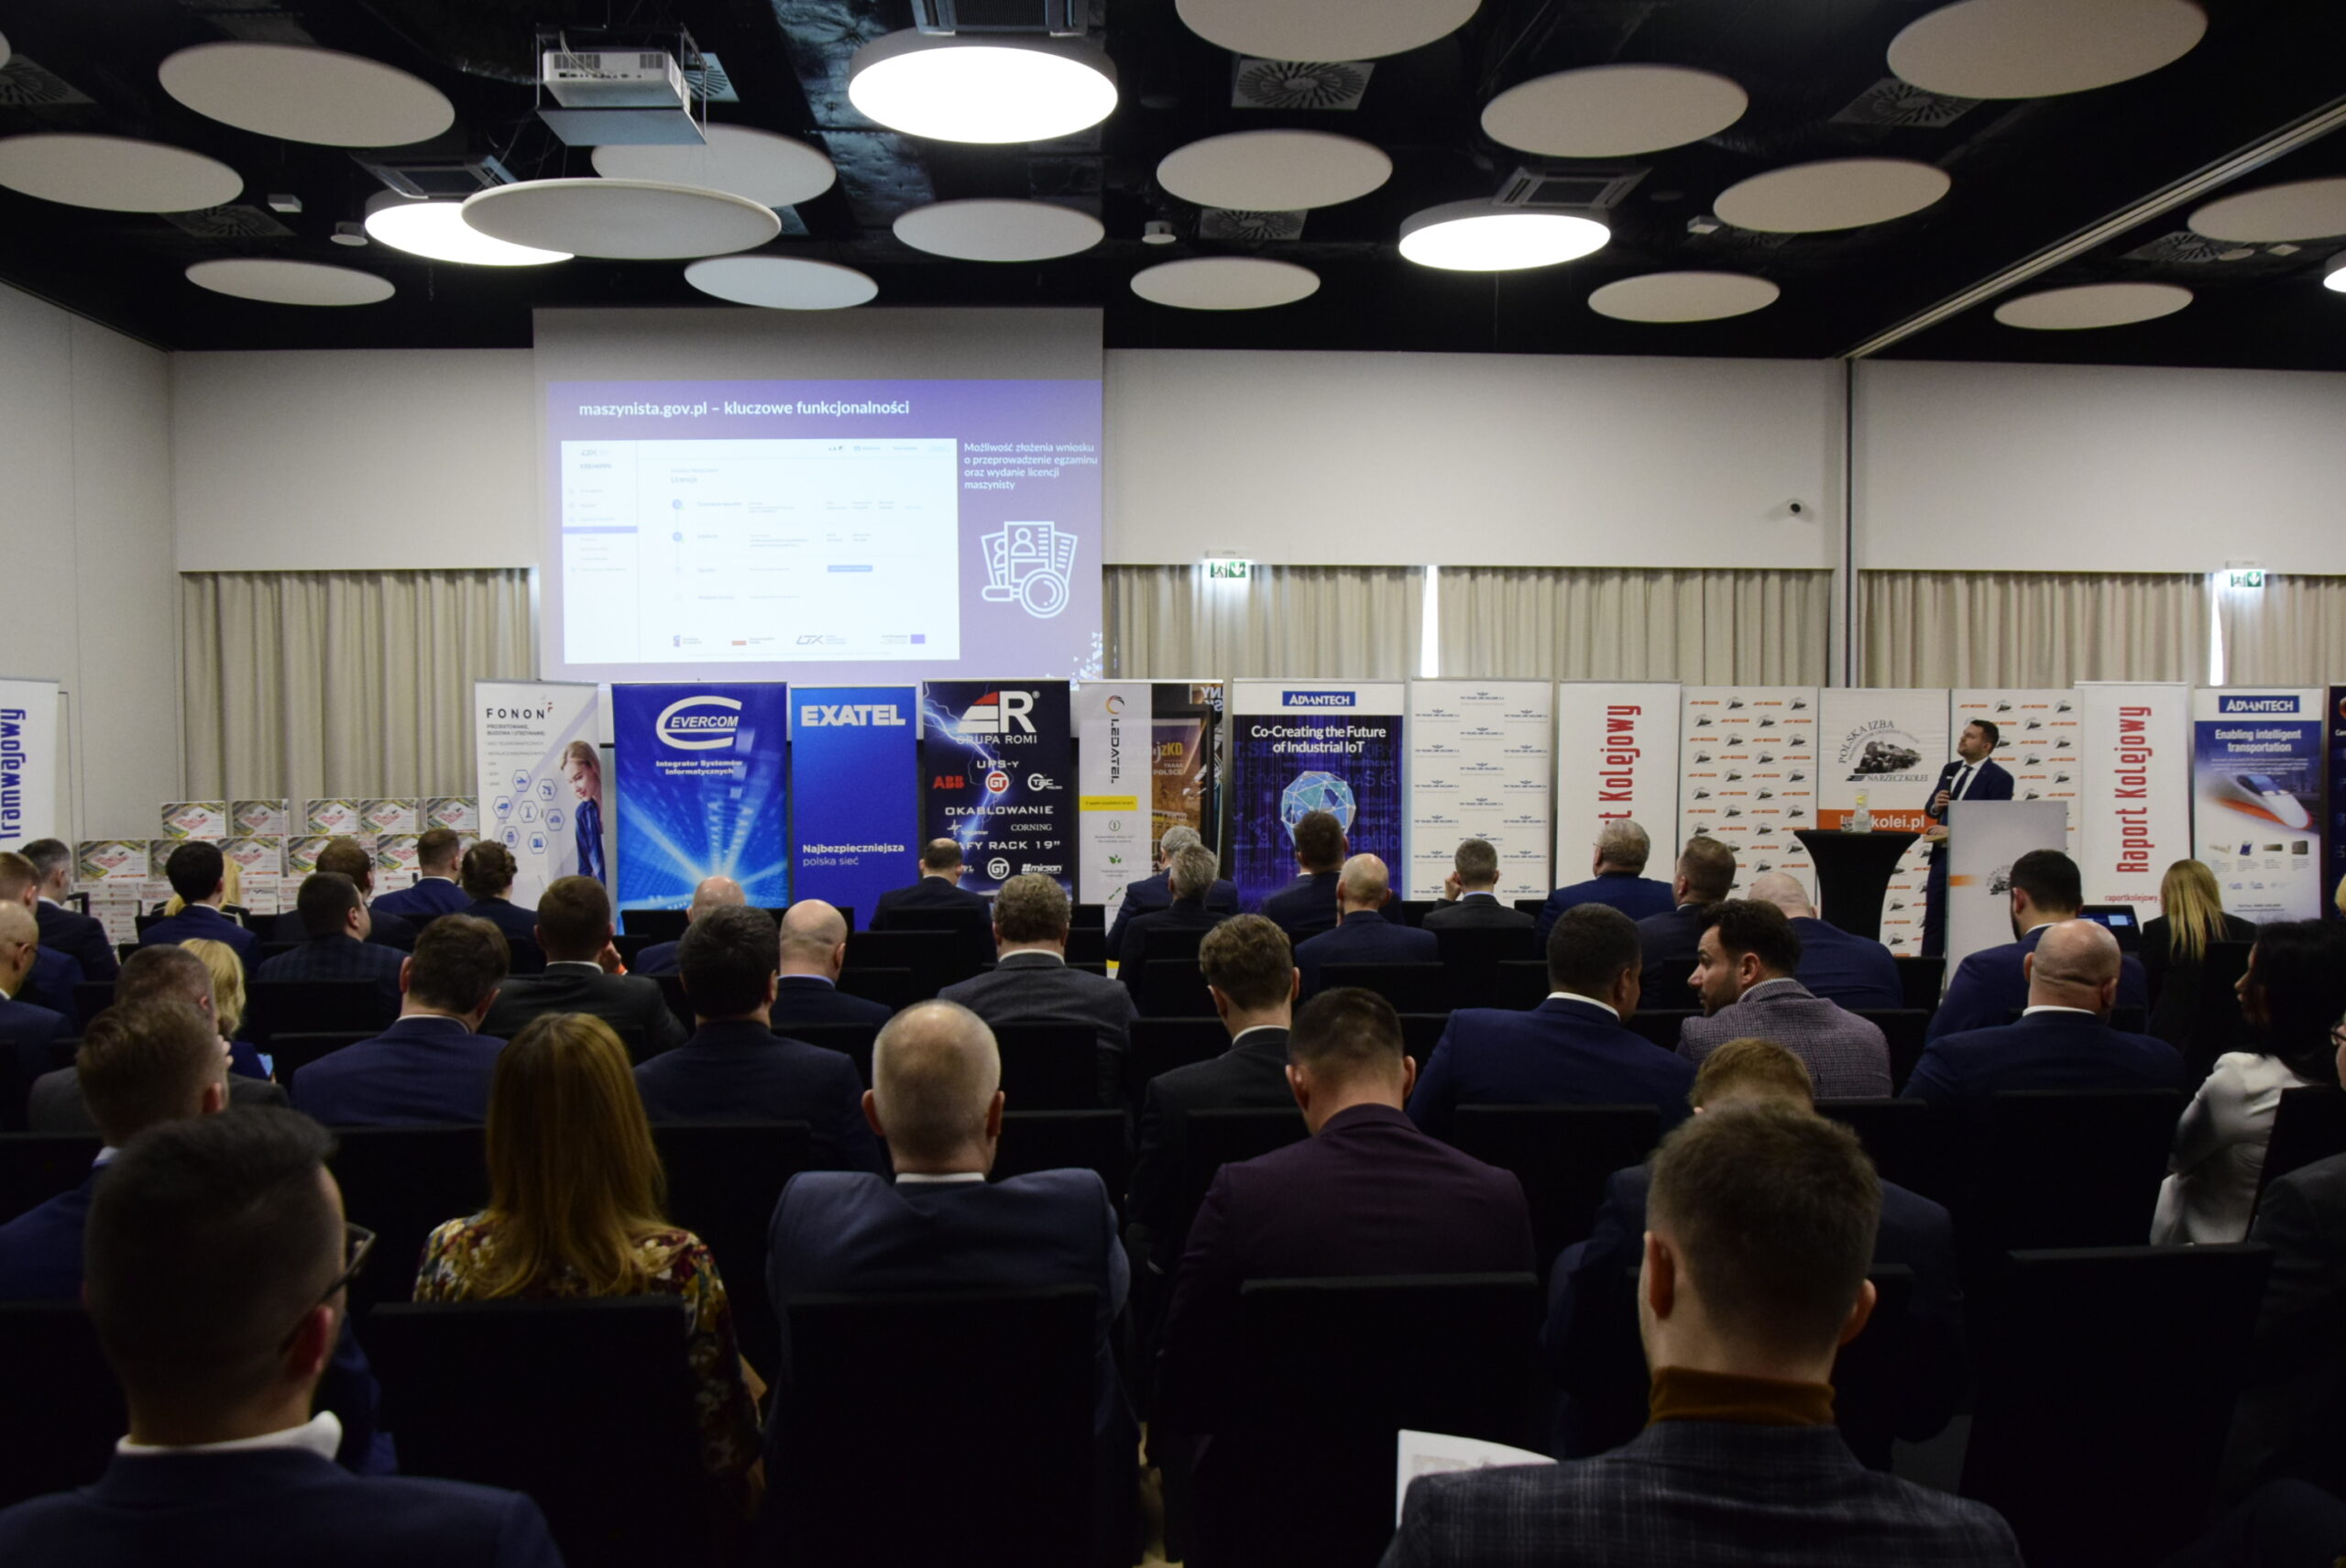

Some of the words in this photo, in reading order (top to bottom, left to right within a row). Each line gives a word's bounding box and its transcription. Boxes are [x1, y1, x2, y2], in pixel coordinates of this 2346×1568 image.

[579, 400, 707, 418] maszynista.gov.pl
[725, 400, 793, 415] kluczowe
[797, 400, 910, 417] funkcjonalności
[964, 442, 1014, 453] Możliwość
[1015, 442, 1054, 453] złożenia
[1056, 443, 1094, 453] wniosku
[964, 456, 970, 465] o
[972, 455, 1052, 466] przeprowadzenie
[1054, 455, 1098, 466] egzaminu
[986, 467, 1025, 478] wydanie
[1027, 467, 1059, 478] licencji
[964, 480, 1015, 490] maszynisty
[1288, 694, 1351, 706] ADVANTECH
[2226, 698, 2294, 712] ADVANTECH
[486, 707, 544, 719] FONON
[800, 704, 907, 727] EXATEL
[670, 716, 740, 729] EVERCOM
[1250, 725, 1324, 740] Co-Creating
[1324, 725, 1345, 738] the
[1346, 725, 1387, 738] Future
[2215, 729, 2254, 741] Enabling
[2255, 729, 2302, 741] intelligent
[955, 734, 1001, 745] GRUPA
[1004, 734, 1037, 744] ROMI
[1837, 725, 1868, 764] POLSKA
[1867, 718, 1895, 731] IZBA
[1272, 740, 1287, 753] of
[1287, 740, 1343, 753] Industrial
[1345, 740, 1365, 753] IoT
[2113, 706, 2154, 799] Kolejowy
[2227, 742, 2292, 754] transportation
[1597, 705, 1642, 802] Kolejowy
[655, 760, 699, 768] Integrator
[699, 759, 743, 768] Systemów
[976, 759, 1020, 769] UPS-Y
[665, 768, 735, 776] Informatycznych
[932, 774, 965, 790] ABB
[988, 776, 1007, 788] GT
[944, 805, 1054, 817] OKABLOWANIE
[1010, 823, 1053, 832] CORNING
[988, 839, 1028, 850] RACK
[2114, 806, 2156, 873] Raport
[802, 843, 905, 855] Najbezpieczniejsza
[803, 856, 837, 867] polska
[839, 856, 860, 866] sieć
